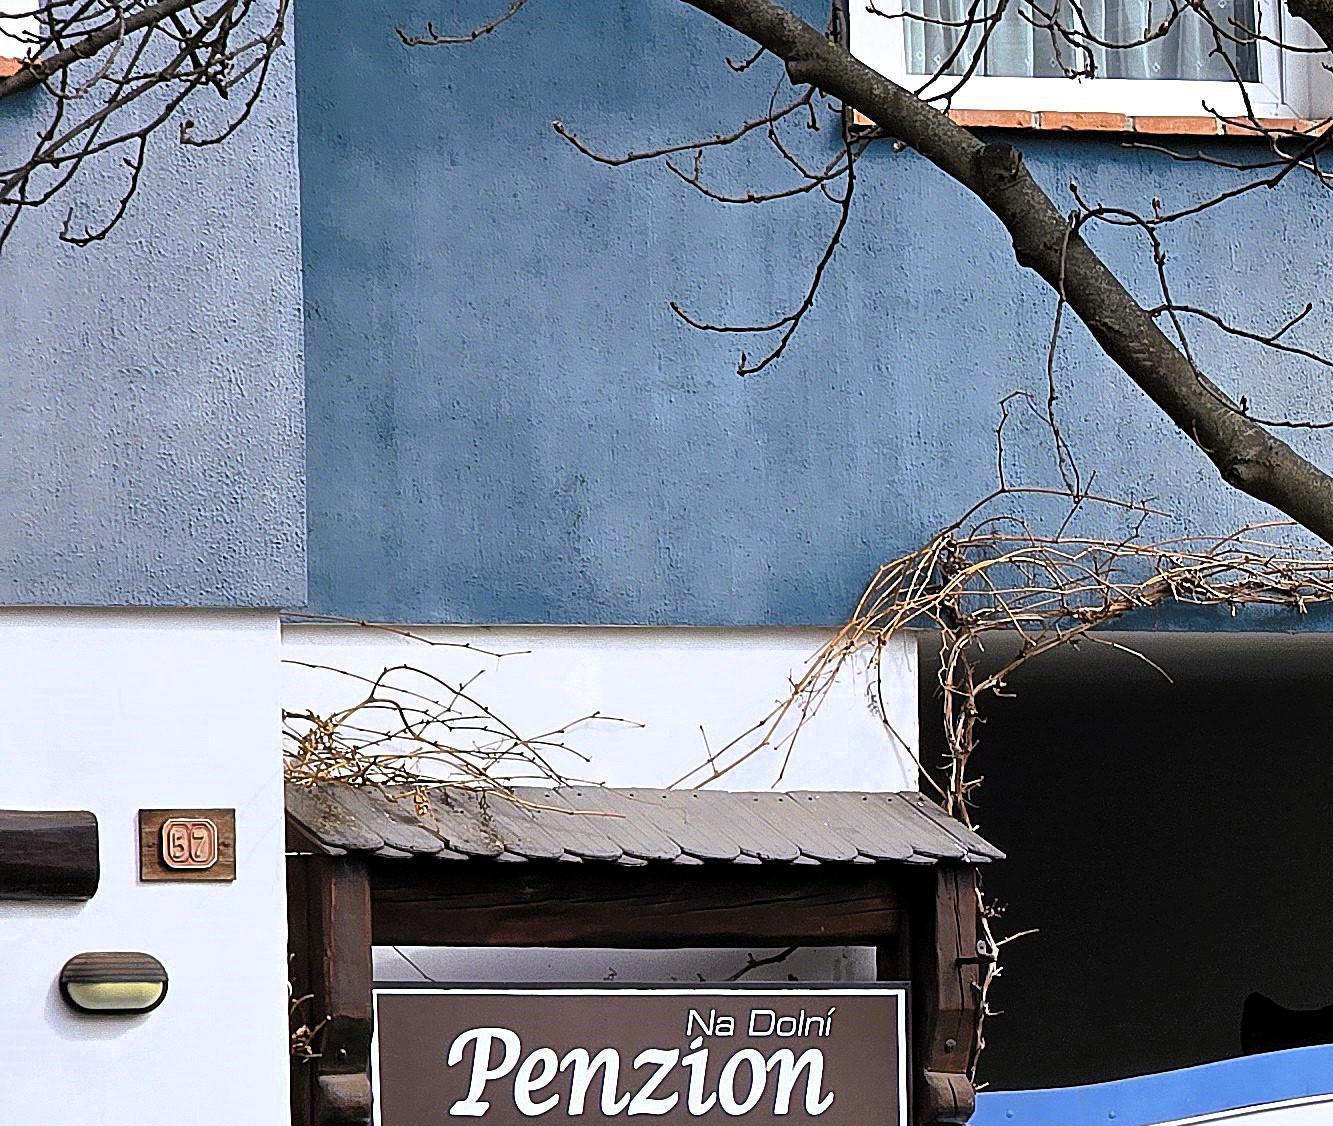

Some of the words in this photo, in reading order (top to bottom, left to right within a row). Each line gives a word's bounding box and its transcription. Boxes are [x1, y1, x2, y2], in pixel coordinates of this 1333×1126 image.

[172, 825, 208, 860] 57
[686, 1008, 736, 1037] Na
[746, 1006, 836, 1037] Dolní
[447, 1026, 835, 1117] Penzion
